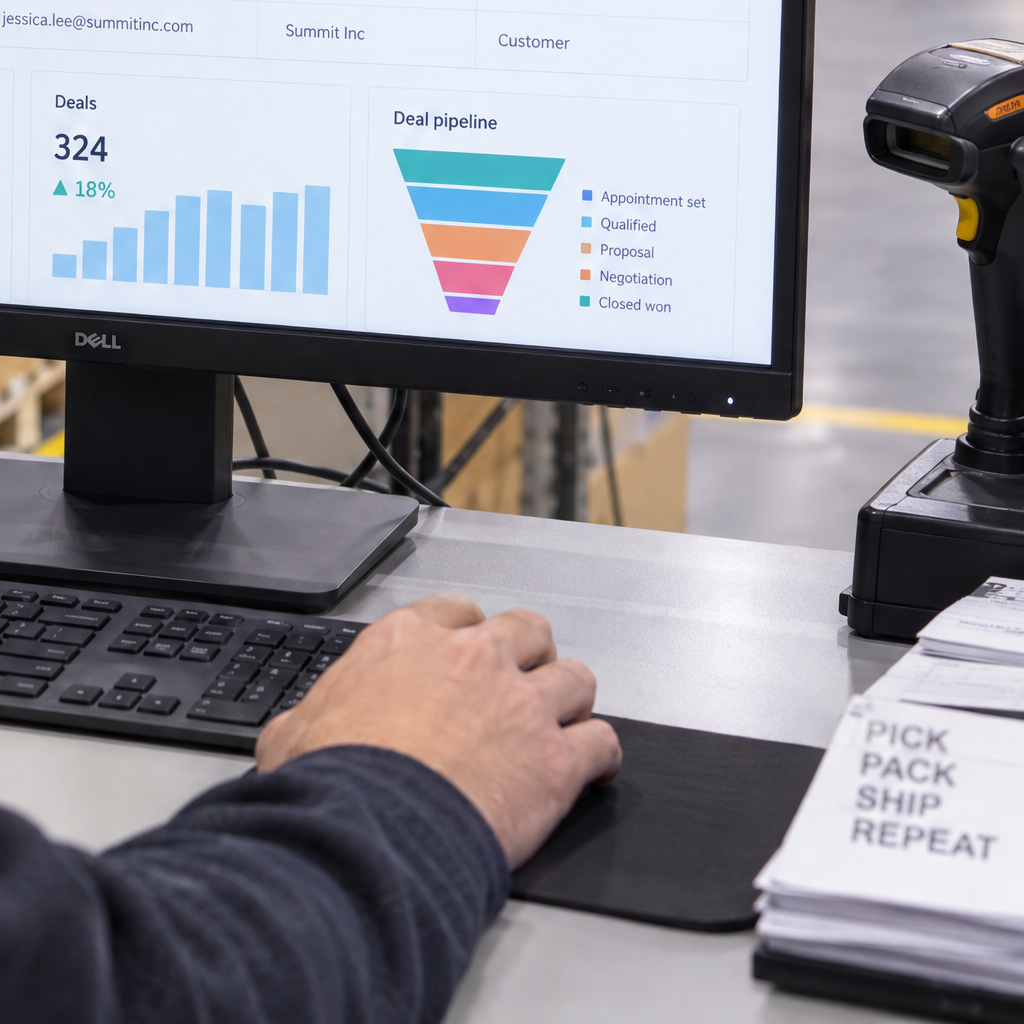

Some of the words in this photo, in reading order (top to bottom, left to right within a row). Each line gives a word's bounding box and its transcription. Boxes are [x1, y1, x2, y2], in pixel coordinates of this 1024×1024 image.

[1, 10, 194, 32] jessica.lee@summitinc.com
[285, 23, 340, 39] Summit
[344, 26, 365, 40] Inc
[498, 33, 571, 49] Customer
[55, 94, 97, 110] Deals
[393, 110, 429, 126] Deal
[433, 112, 498, 131] pipeline
[53, 133, 109, 162] 324
[75, 180, 116, 198] 18%
[600, 190, 684, 207] Appointment
[686, 197, 707, 208] set
[600, 217, 657, 232] Qualified
[600, 243, 655, 260] Proposal
[599, 269, 673, 286] Negotiation
[598, 296, 642, 310] Closed
[644, 302, 672, 312] won
[75, 332, 121, 349] DELL
[866, 720, 950, 754] PICK
[860, 751, 957, 788] PACK
[856, 784, 941, 817] SHIP
[851, 817, 999, 861] REPEAT
